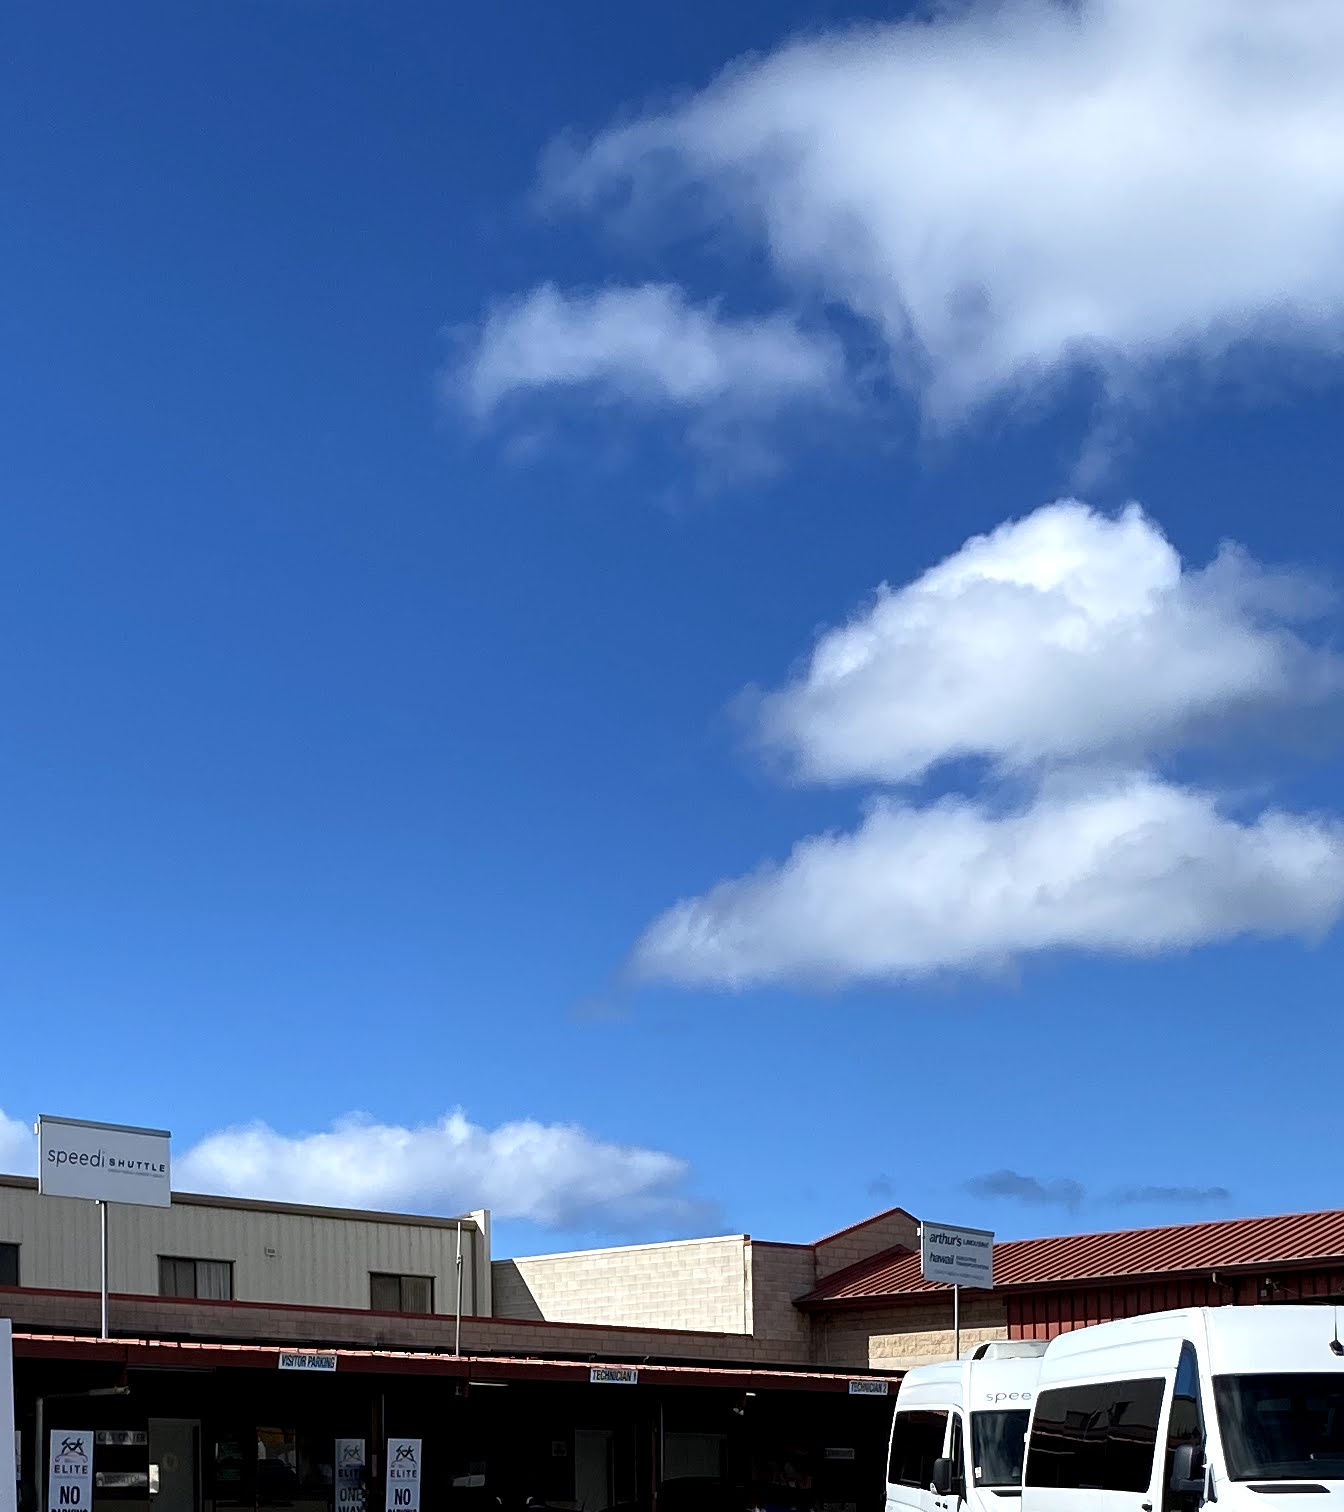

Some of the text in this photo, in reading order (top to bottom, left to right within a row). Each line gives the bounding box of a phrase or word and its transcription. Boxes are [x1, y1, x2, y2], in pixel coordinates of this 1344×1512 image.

[47, 1149, 105, 1168] speedi
[109, 1158, 166, 1173] SHUTTLE
[929, 1232, 962, 1247] arthur's
[281, 1354, 335, 1369] VISITOR PARKING
[592, 1369, 632, 1382] TECHNICIAN
[851, 1381, 887, 1393] TECHNICIAN 2
[54, 1465, 88, 1474] ELITE
[390, 1470, 417, 1478] ELITE
[59, 1486, 81, 1504] NO
[340, 1488, 362, 1501] ONE
[394, 1488, 411, 1505] NO
